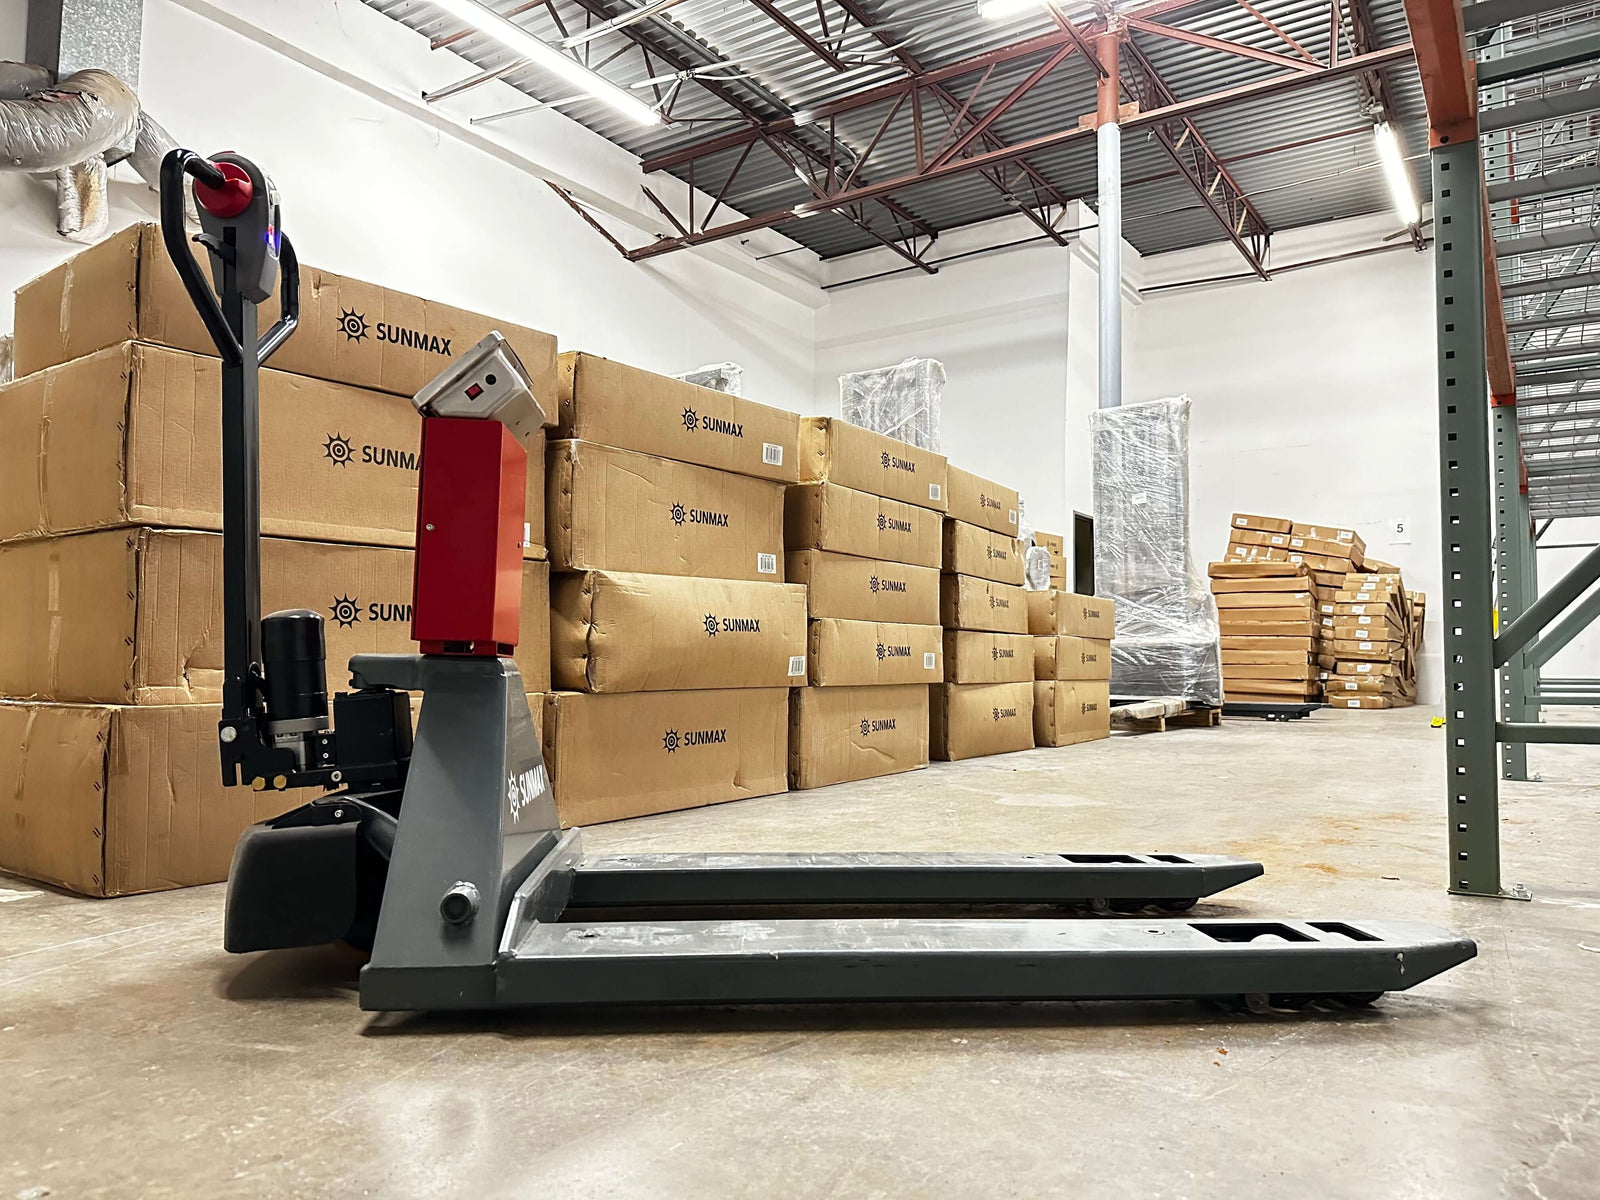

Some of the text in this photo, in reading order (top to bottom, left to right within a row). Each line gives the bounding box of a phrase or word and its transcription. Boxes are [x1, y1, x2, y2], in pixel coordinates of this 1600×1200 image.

[376, 322, 452, 357] SUNMAX
[702, 415, 744, 438] SUNMAX
[891, 456, 916, 473] SUNMAX
[689, 508, 729, 528] SUNMAX
[888, 518, 912, 533] SUNMAX
[1396, 523, 1404, 533] 5
[881, 579, 907, 593] SUNMAX
[722, 618, 761, 633] SUNMAX
[887, 645, 912, 657] SUNMAX
[871, 718, 896, 732] SUNMAX
[684, 728, 727, 746] SUNMAX
